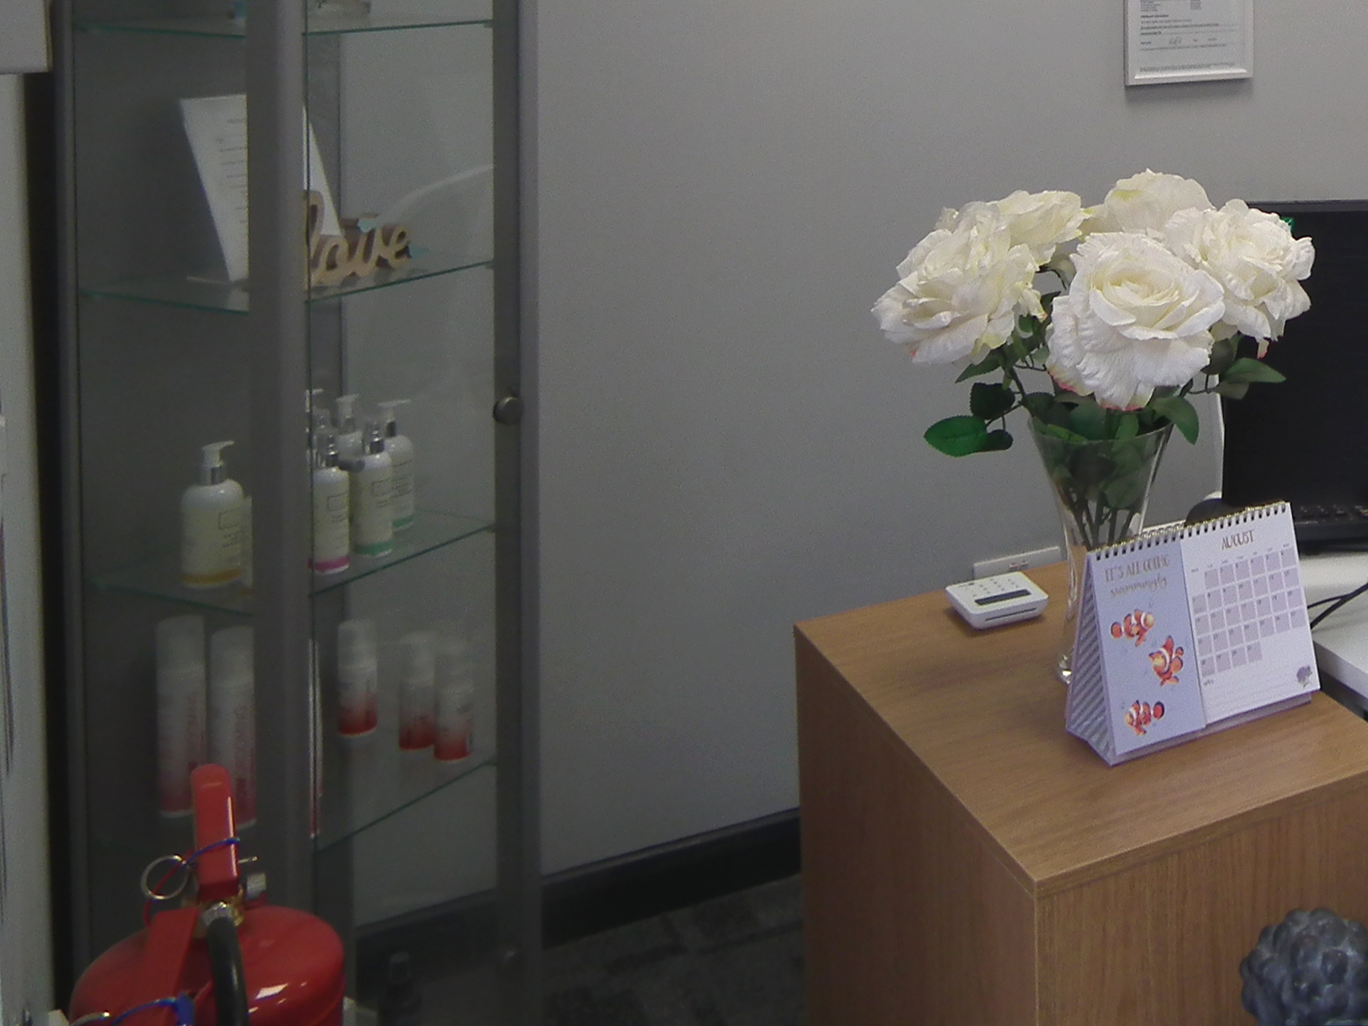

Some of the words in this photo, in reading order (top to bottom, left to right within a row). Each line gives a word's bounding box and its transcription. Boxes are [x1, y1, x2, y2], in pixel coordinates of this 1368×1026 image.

[1221, 529, 1255, 551] AUGUST
[1126, 560, 1140, 577] ALL
[1142, 553, 1170, 573] GOING
